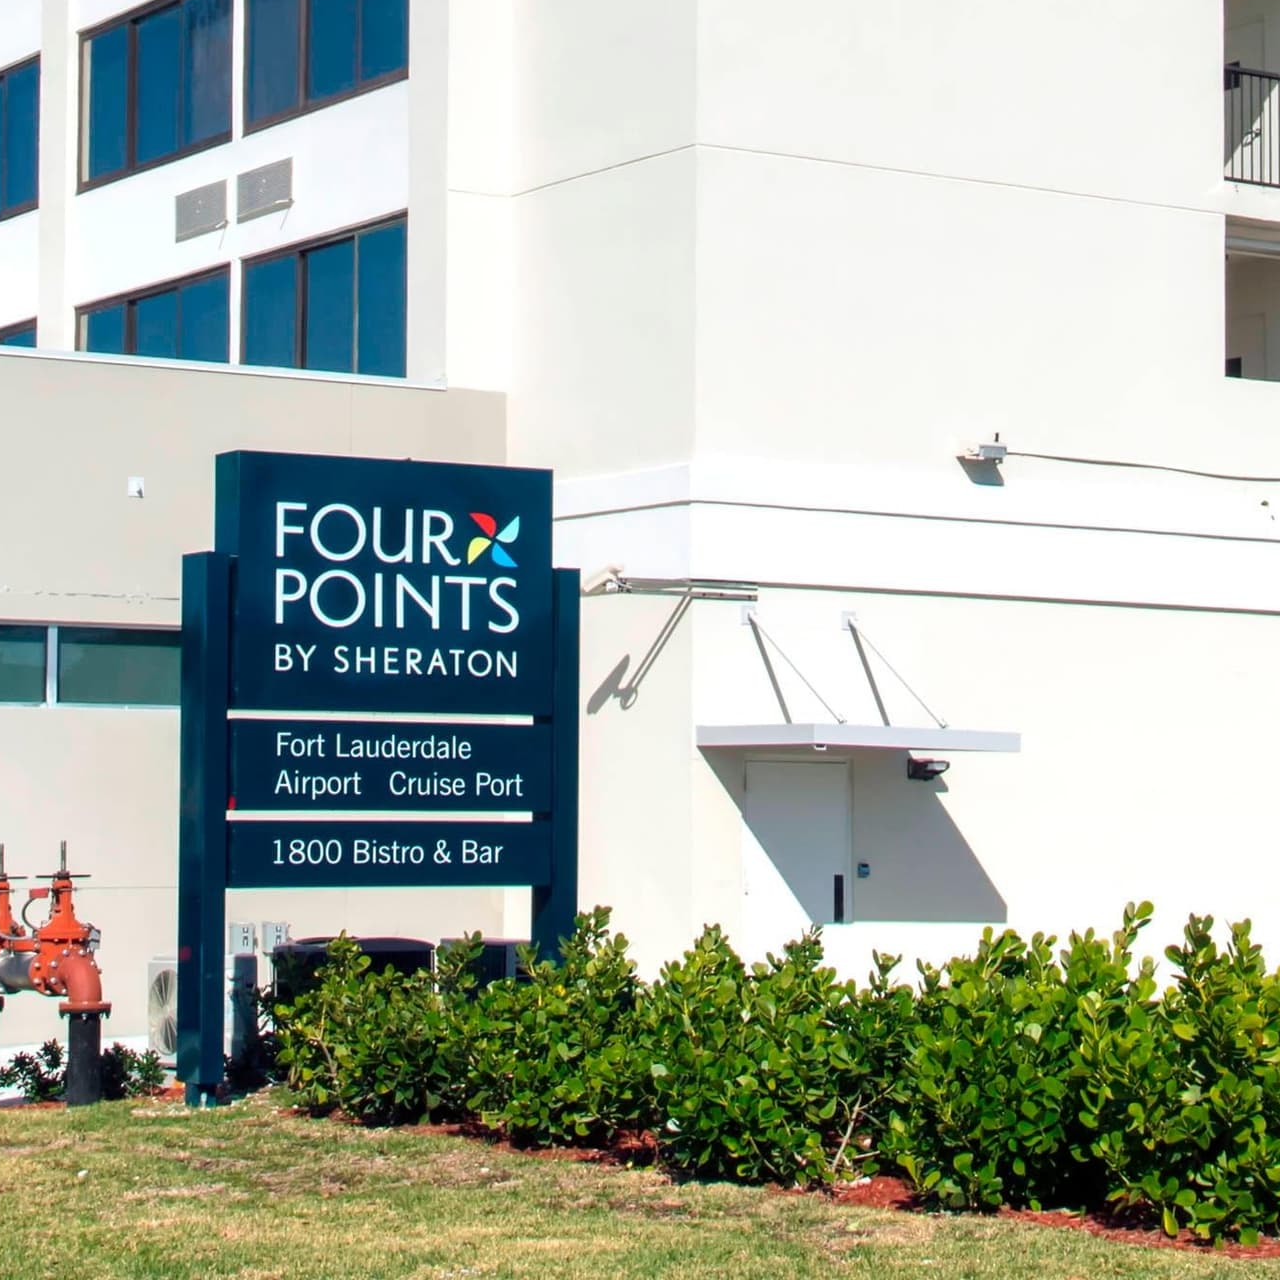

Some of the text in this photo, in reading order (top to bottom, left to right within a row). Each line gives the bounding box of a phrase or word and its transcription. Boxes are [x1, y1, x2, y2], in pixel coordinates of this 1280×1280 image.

[276, 501, 462, 567] FOUR
[275, 568, 520, 634] POINTS
[274, 643, 518, 678] BY SHERATON
[276, 732, 472, 760] Fort Lauderdale
[274, 769, 524, 800] Airport Cruise Port
[272, 839, 504, 865] 1800 Bistro & Bar
